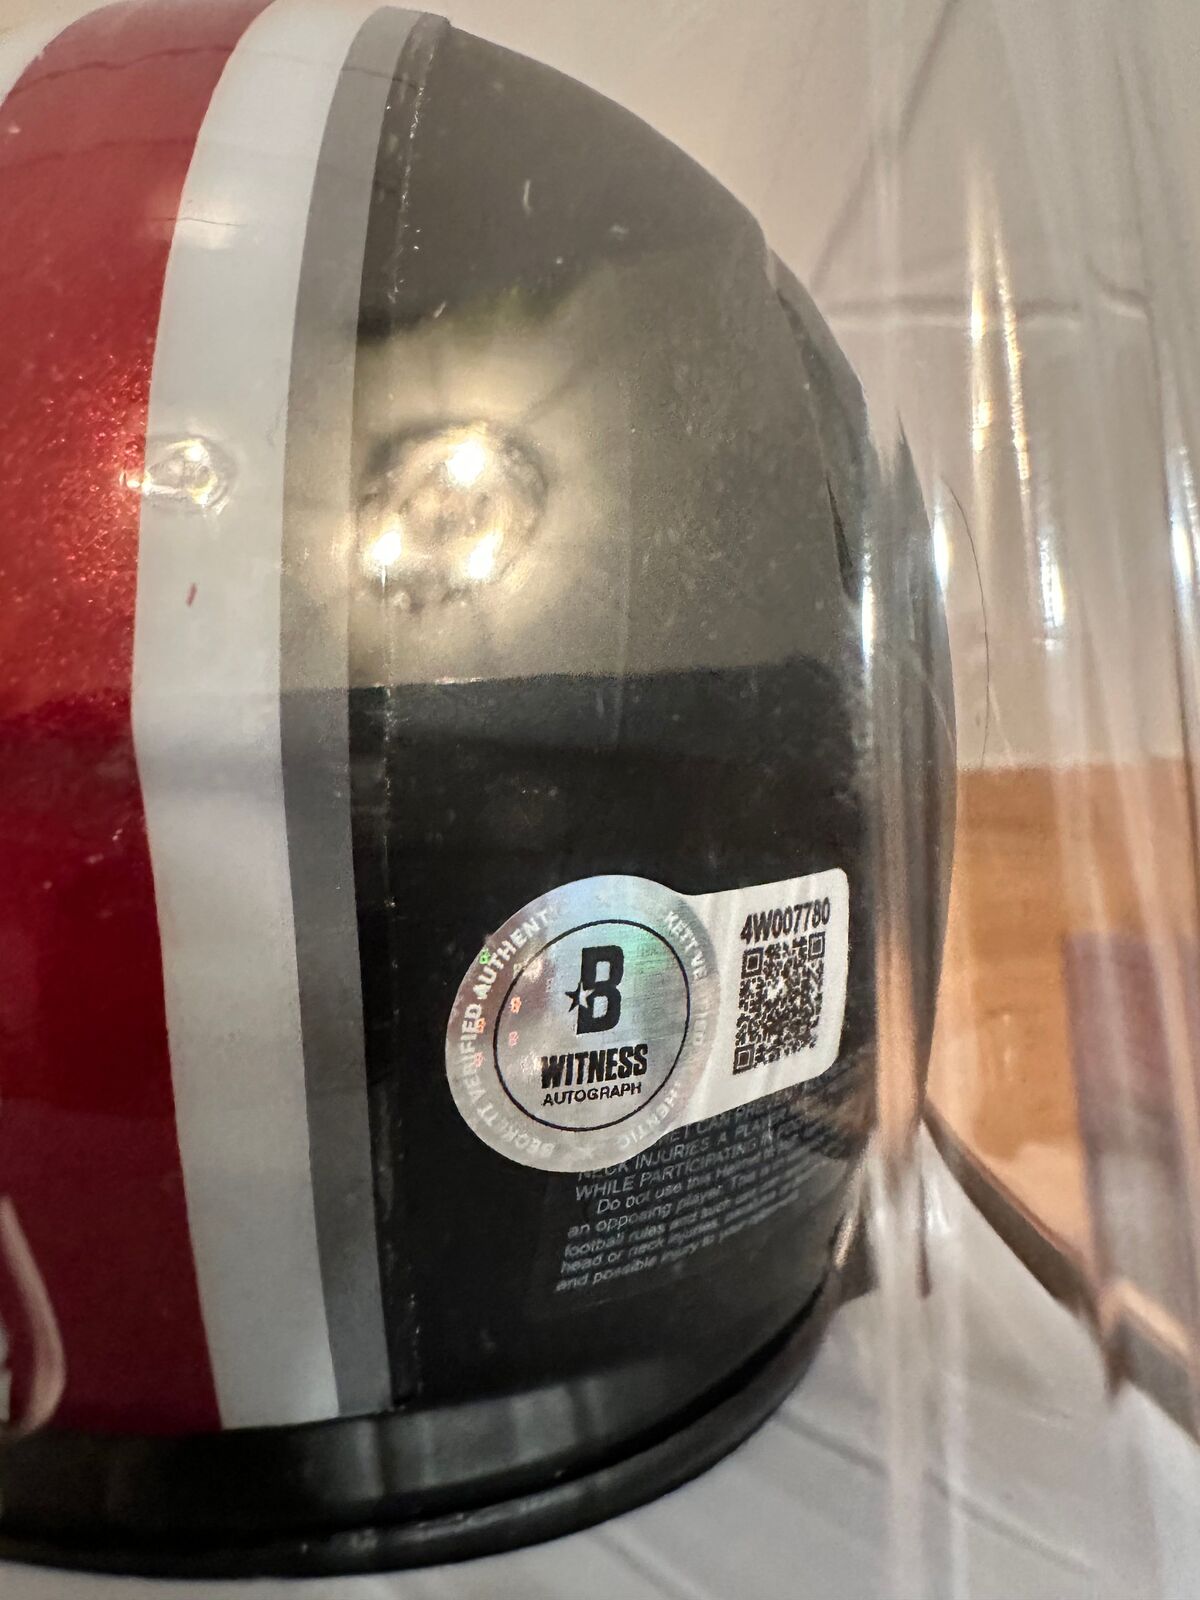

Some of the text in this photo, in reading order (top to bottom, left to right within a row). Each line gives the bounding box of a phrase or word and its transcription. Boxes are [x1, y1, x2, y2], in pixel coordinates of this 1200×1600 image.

[740, 896, 831, 944] 4W007780
[472, 903, 556, 1000] AUTHENT
[540, 1044, 649, 1089] WITNESS
[542, 1082, 642, 1106] AUTOGRAPH
[575, 1174, 635, 1201] WHILE
[639, 1138, 757, 1187] PARTICIPATING
[634, 1137, 710, 1170] INJURIES
[596, 1197, 622, 1214] Do
[654, 1182, 682, 1200] use
[567, 1223, 591, 1240] an
[594, 1203, 672, 1233] opposing
[606, 1249, 624, 1263] or
